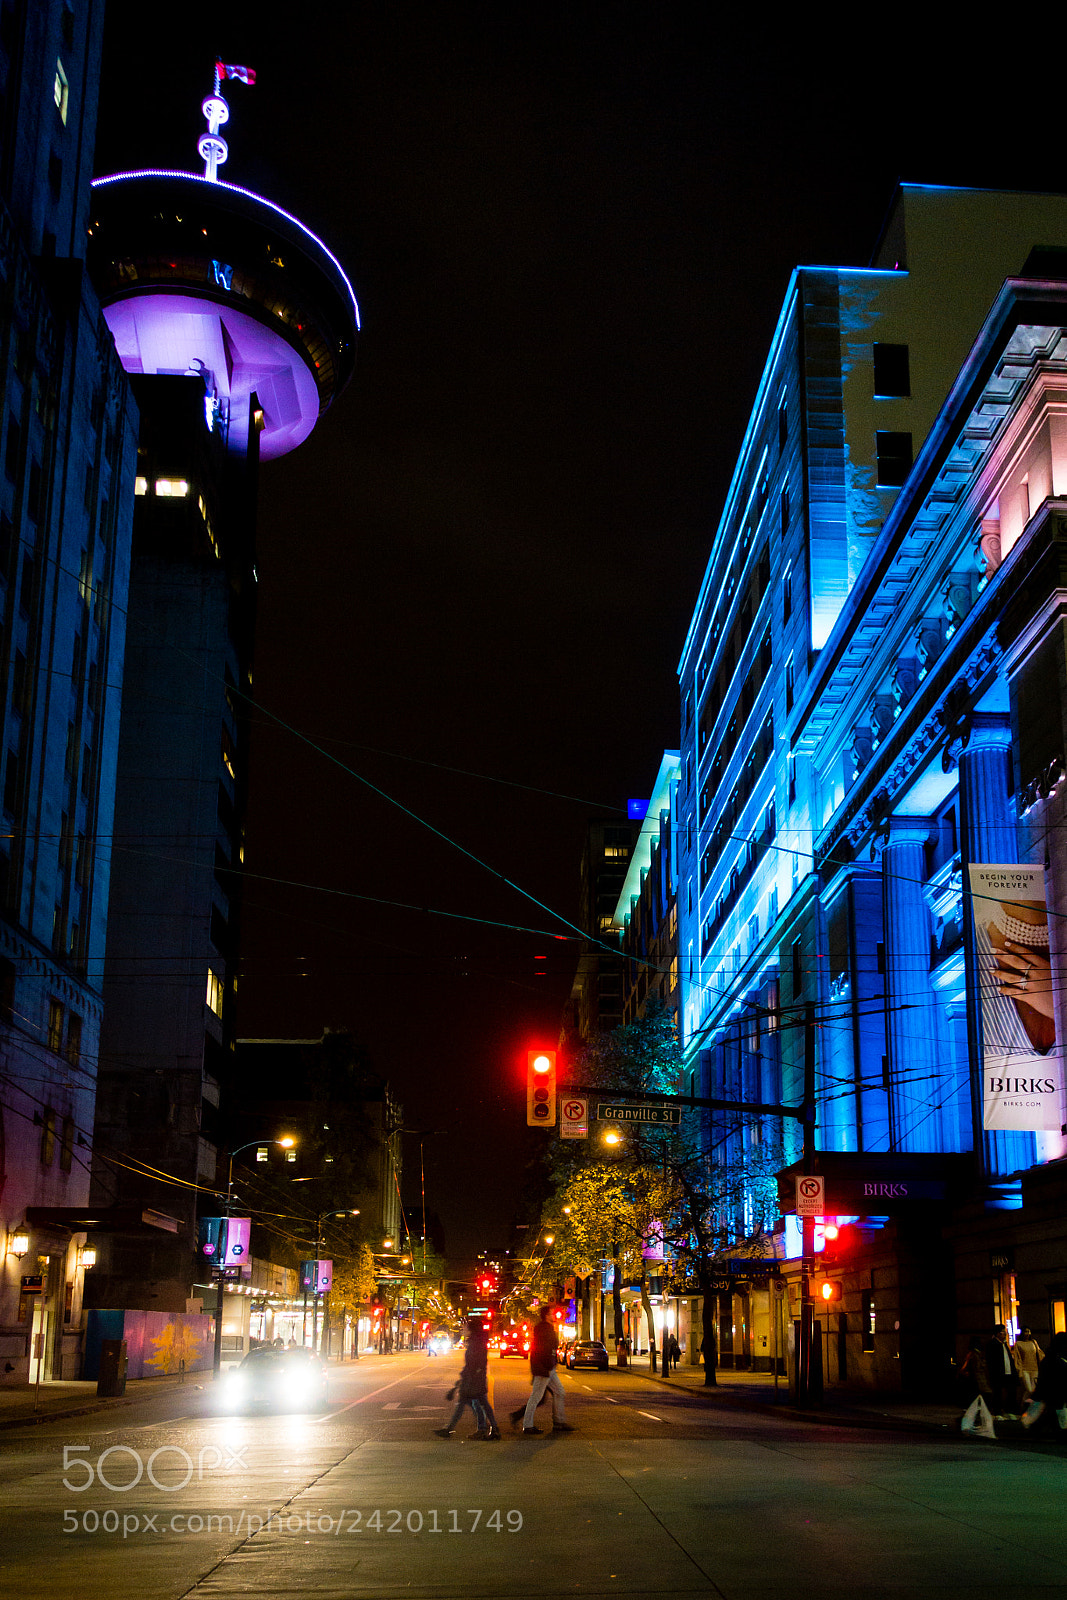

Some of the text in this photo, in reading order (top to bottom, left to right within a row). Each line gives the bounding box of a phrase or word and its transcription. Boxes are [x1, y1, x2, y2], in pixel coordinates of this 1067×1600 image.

[980, 873, 1007, 881] BEGIN
[989, 1077, 1055, 1093] BIRKS
[605, 1107, 673, 1121] Granville St
[863, 1183, 908, 1198] BIRKS
